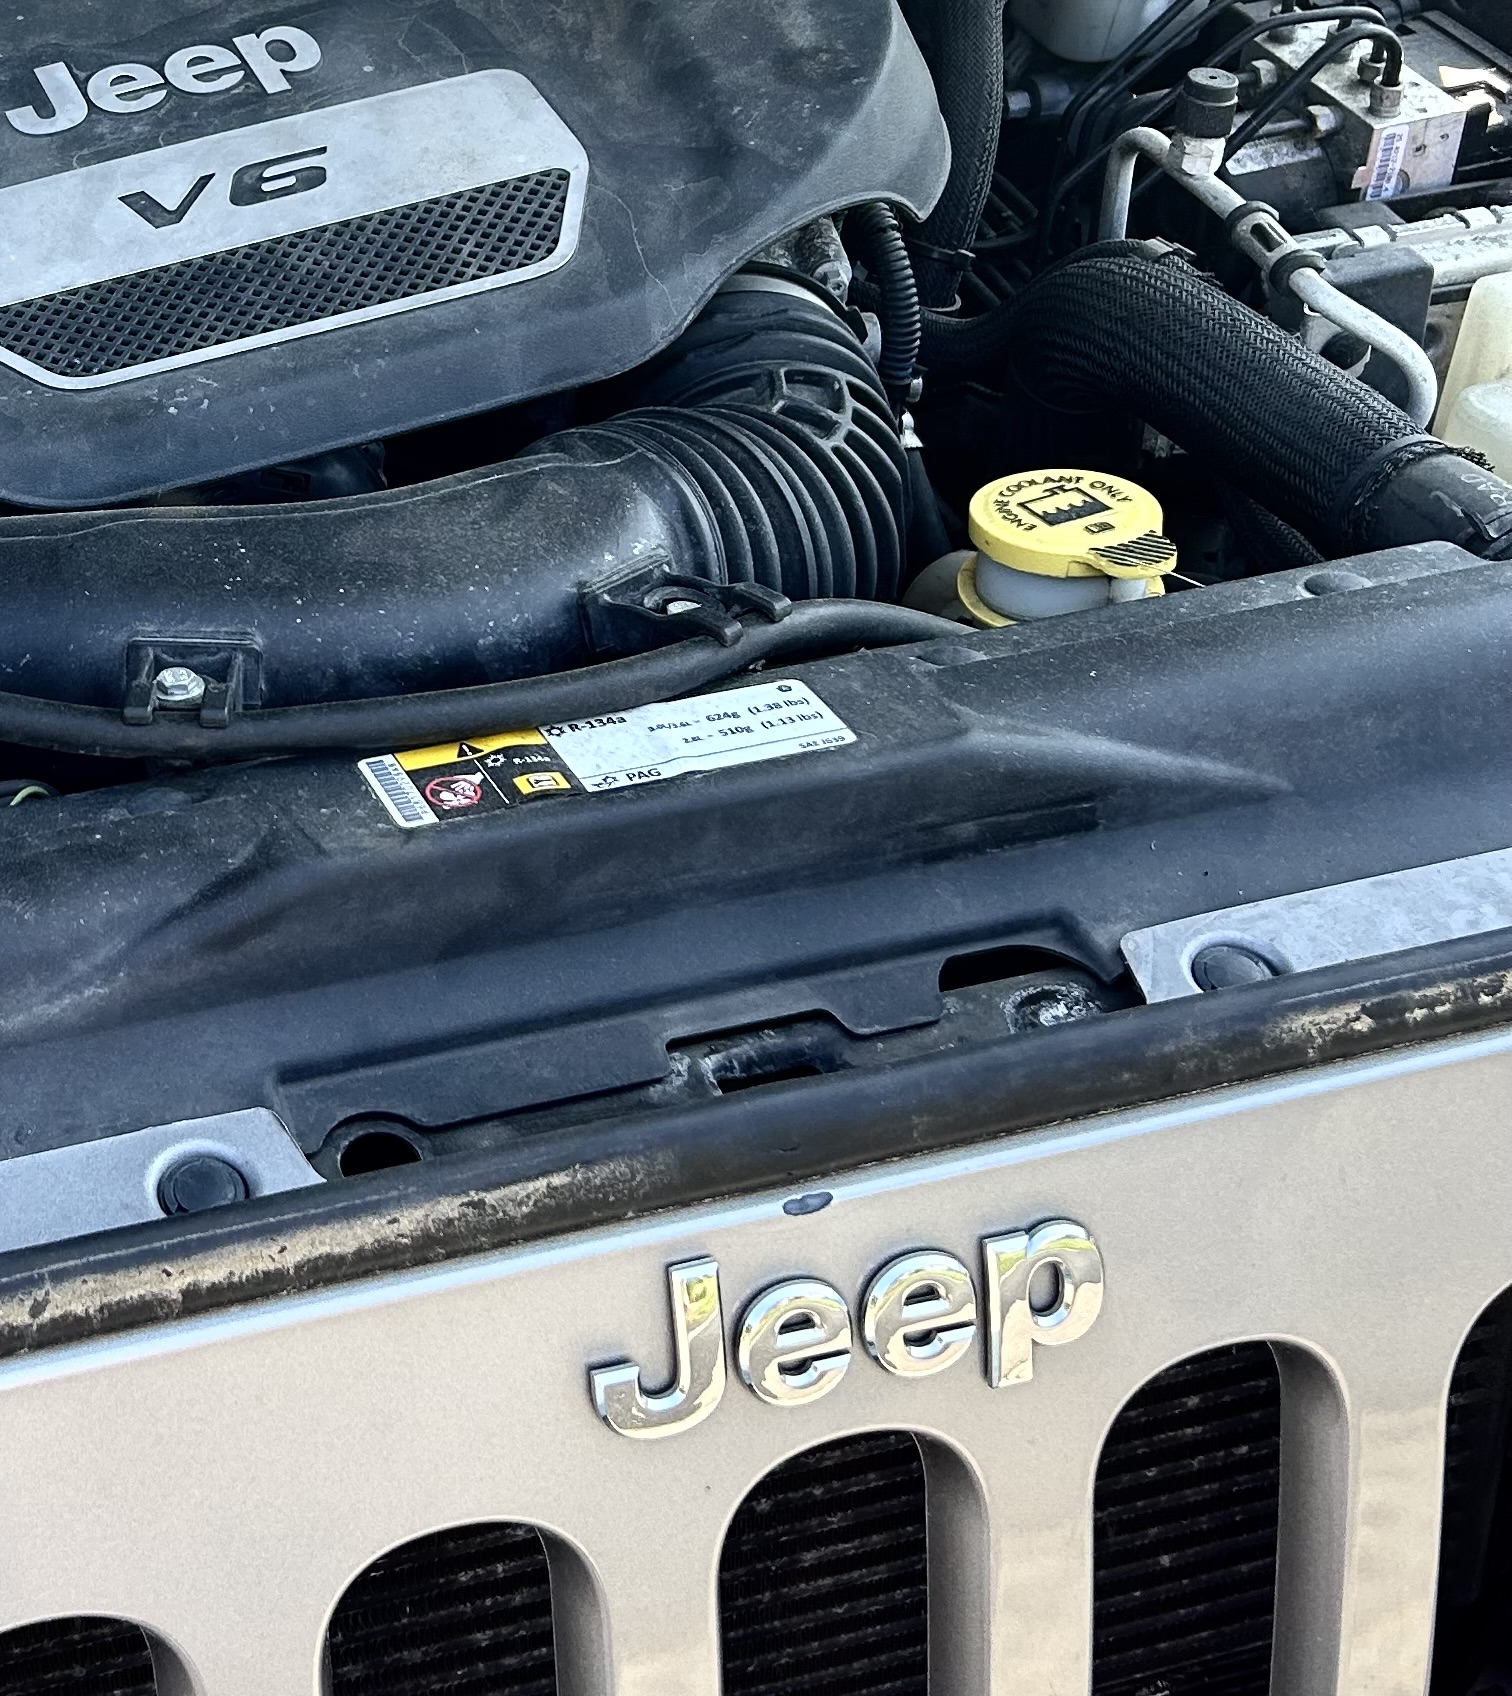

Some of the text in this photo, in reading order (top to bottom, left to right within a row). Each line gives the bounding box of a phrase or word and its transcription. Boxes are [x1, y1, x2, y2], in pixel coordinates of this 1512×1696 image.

[4, 25, 321, 135] Jeep
[118, 145, 328, 229] V6
[992, 475, 1133, 532] ENGINE COOLANT ONLY
[568, 716, 627, 733] R-134a
[705, 711, 741, 723] 624g
[747, 701, 783, 715] (1.38
[785, 697, 811, 708] lbs)
[718, 725, 754, 737] 510g
[760, 716, 796, 729] (1.13
[798, 711, 824, 722] lbs)
[626, 768, 662, 782] PAG
[588, 1217, 1105, 1440] Jeep
